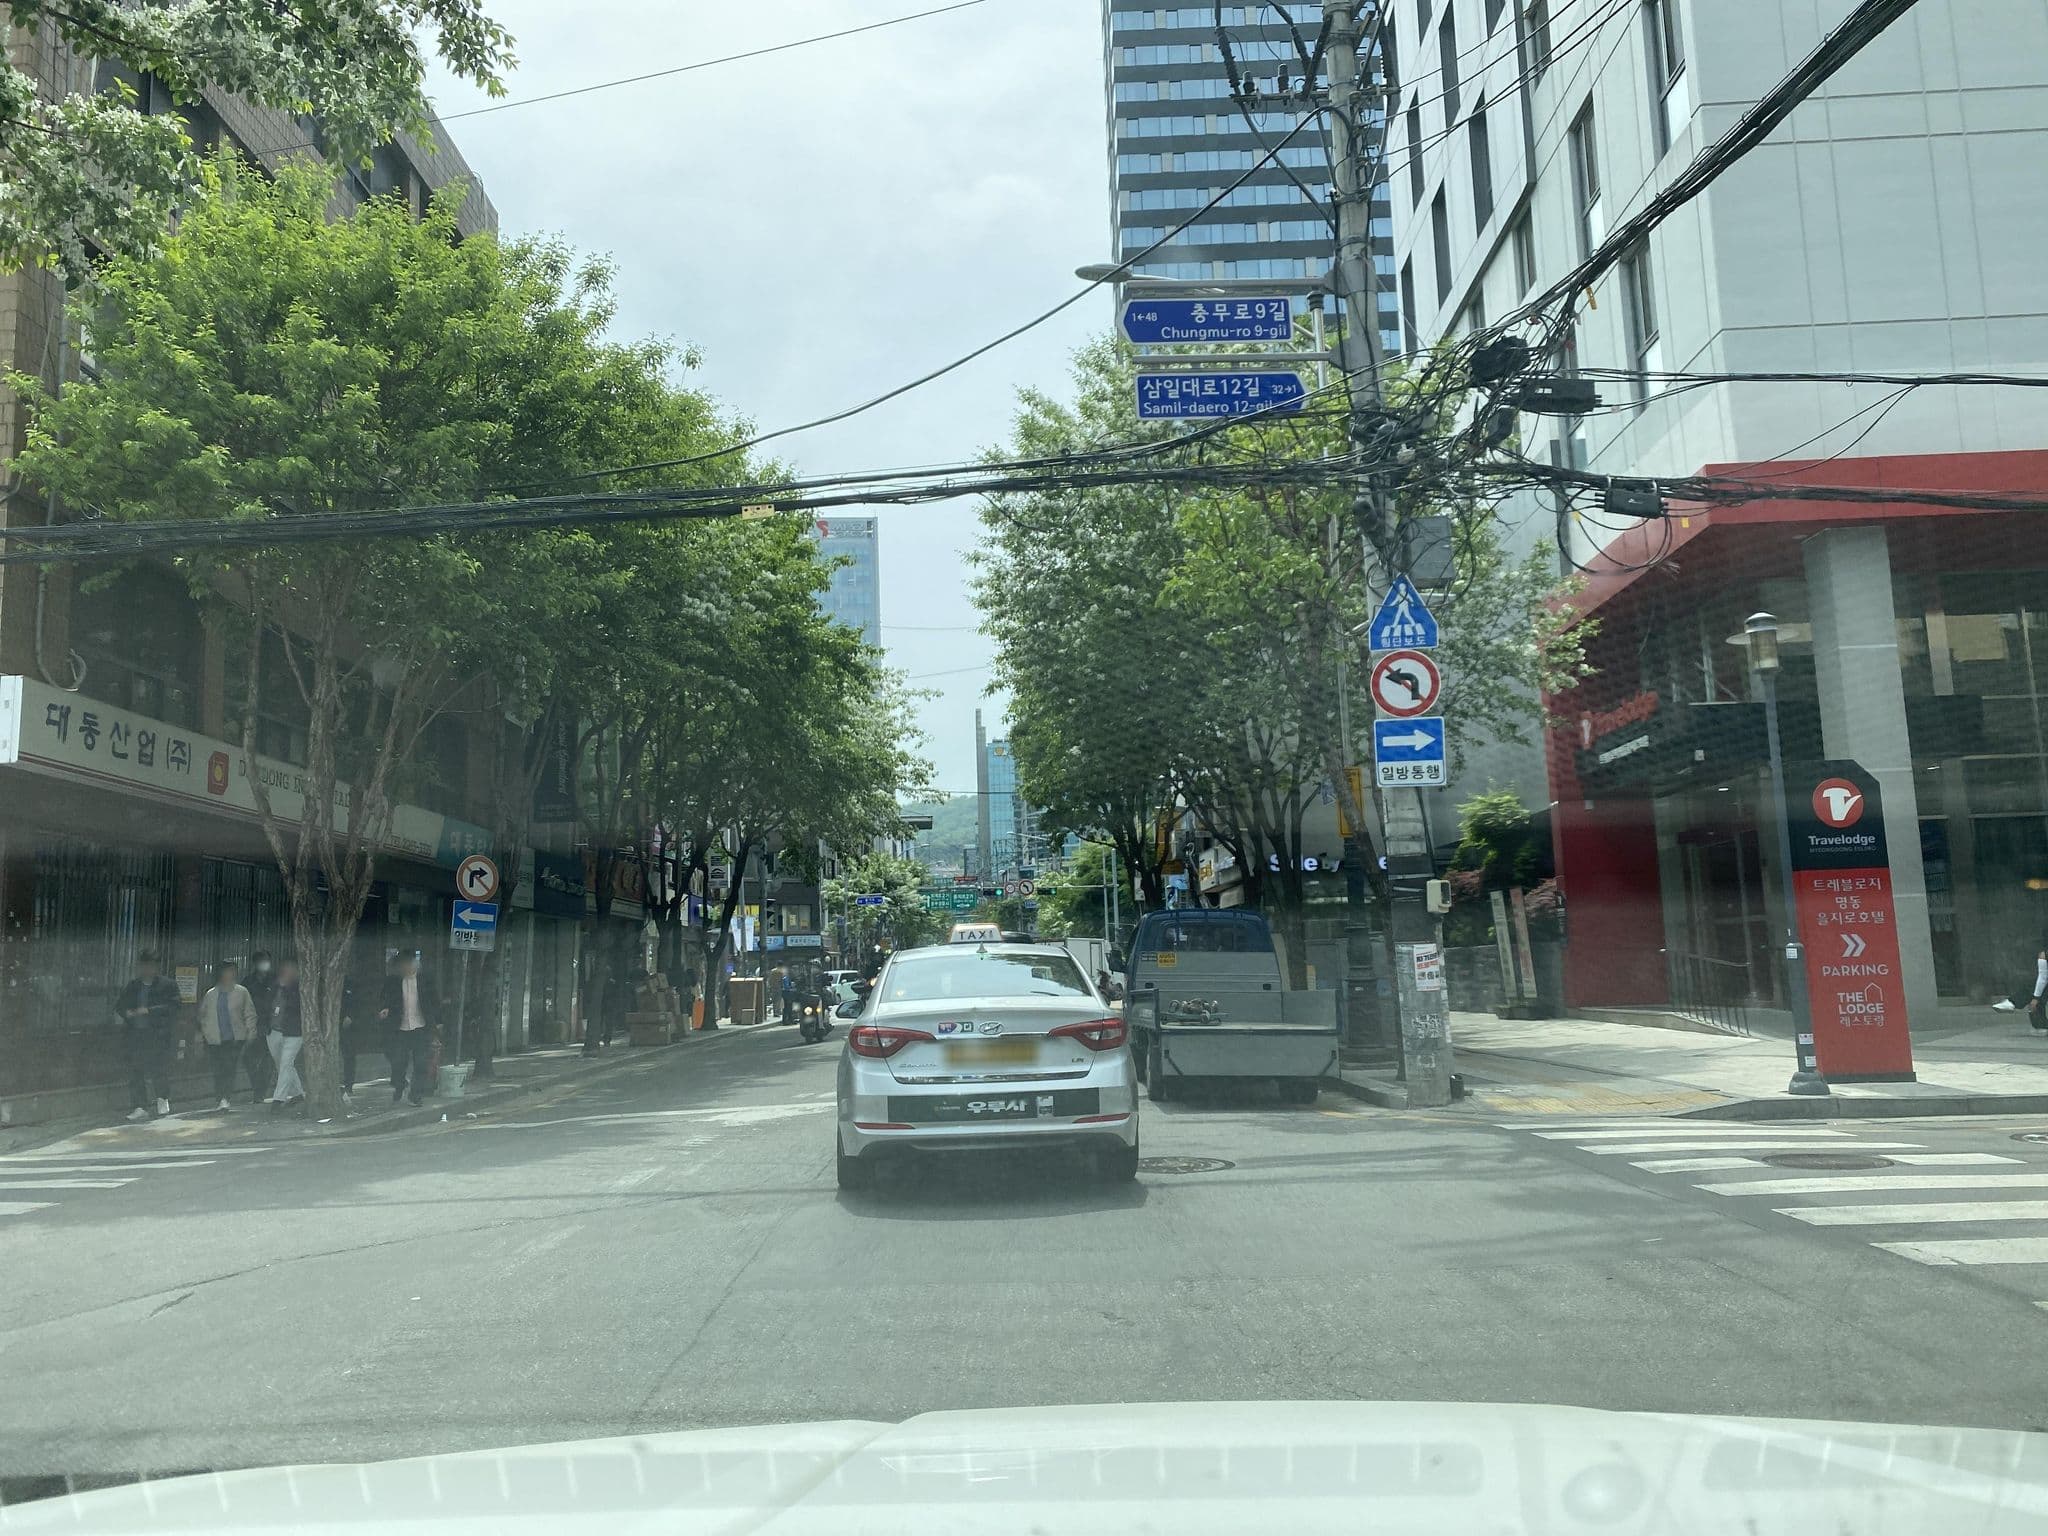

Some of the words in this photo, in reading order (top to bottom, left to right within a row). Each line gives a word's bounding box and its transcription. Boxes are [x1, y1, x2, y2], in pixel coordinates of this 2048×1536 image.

[1190, 301, 1286, 324] 충무로9길
[1161, 326, 1251, 341] Chungmu-ro
[1254, 325, 1287, 340] 9-gil
[1143, 376, 1260, 399] 삼일대로12길
[1143, 402, 1229, 415] Samil-daero
[1234, 400, 1273, 413] 12-gil
[1381, 636, 1427, 648] 횡단보도
[1381, 764, 1440, 781] 일방통행
[1808, 834, 1876, 846] Travelodge
[1813, 877, 1881, 892] 트레블로지
[1835, 895, 1862, 910] 명동
[1817, 911, 1885, 926] 을지로호텔
[1822, 963, 1889, 977] PARKING
[1837, 992, 1864, 1003] THE
[1838, 1003, 1885, 1015] LODGE
[1839, 1015, 1885, 1027] 레스토랑
